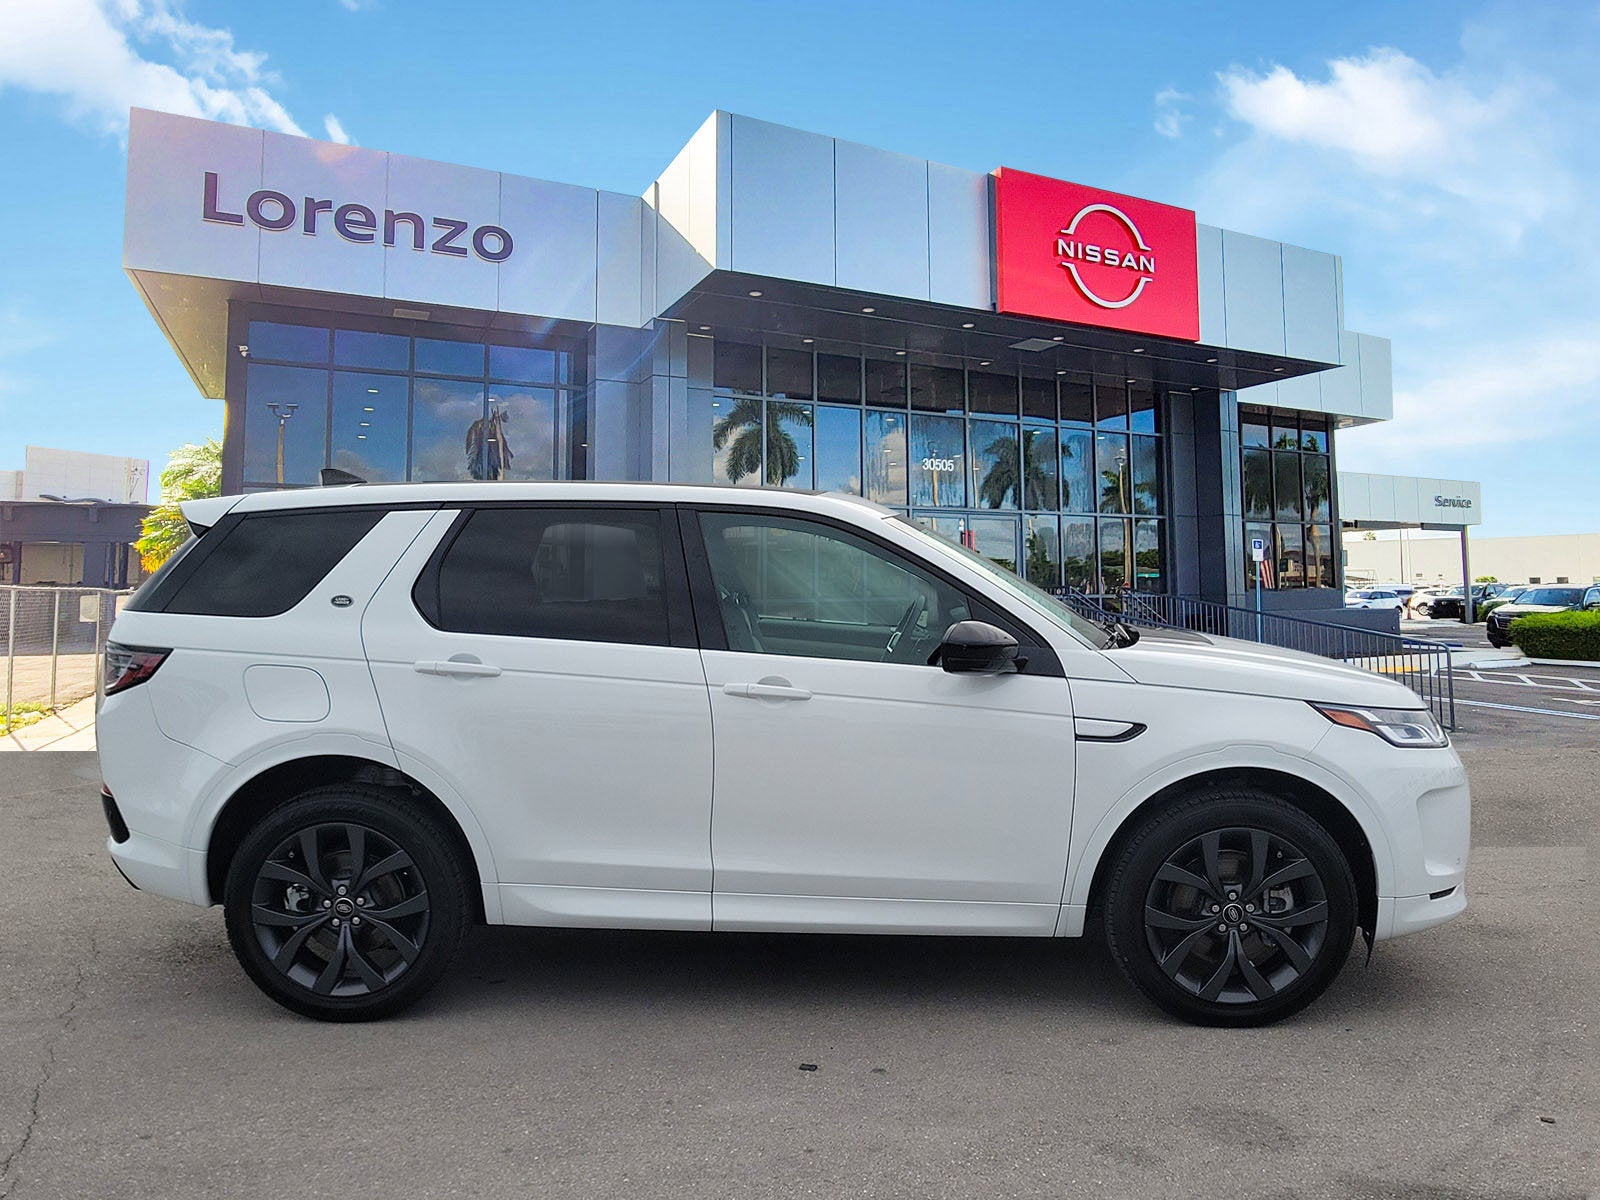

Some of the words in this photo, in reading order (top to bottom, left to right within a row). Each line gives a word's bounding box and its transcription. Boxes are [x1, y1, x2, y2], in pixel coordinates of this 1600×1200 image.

[203, 171, 514, 263] Lorenzo
[1057, 238, 1155, 273] NISSAN
[922, 458, 954, 472] 30505
[1434, 495, 1472, 509] Service
